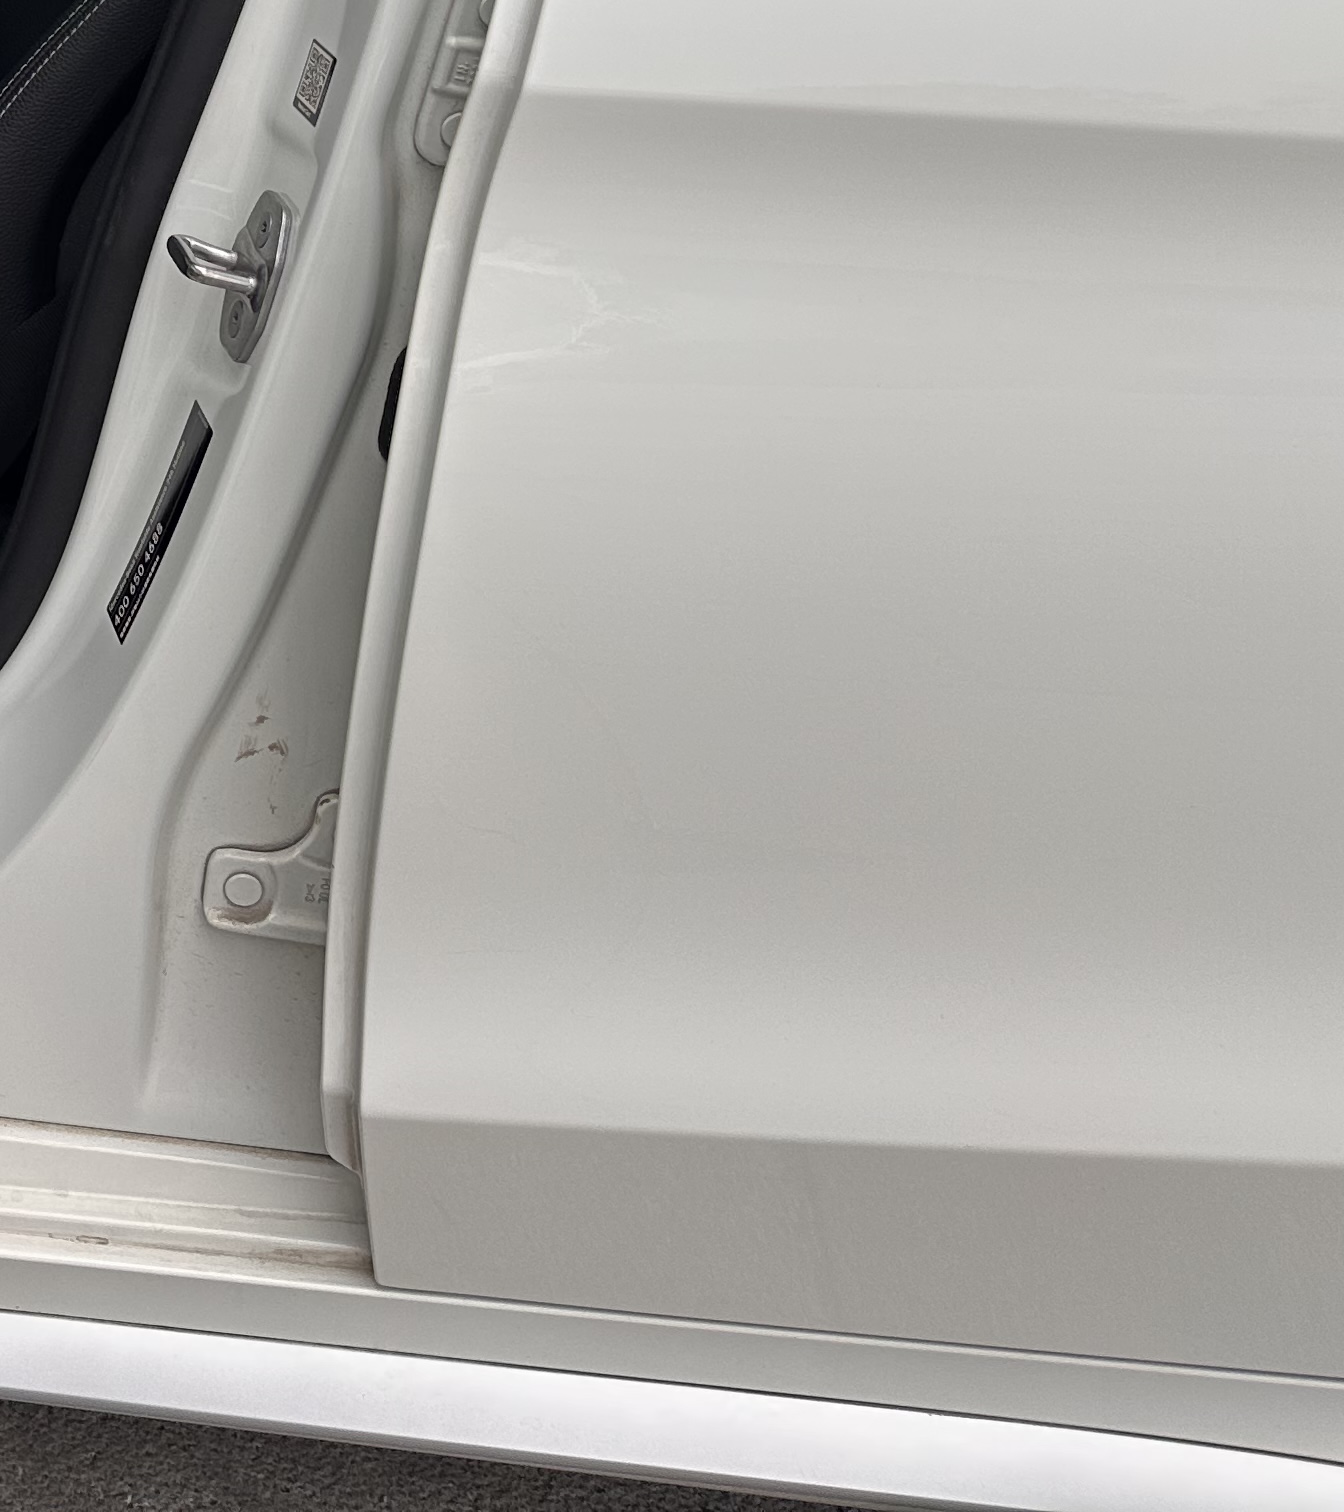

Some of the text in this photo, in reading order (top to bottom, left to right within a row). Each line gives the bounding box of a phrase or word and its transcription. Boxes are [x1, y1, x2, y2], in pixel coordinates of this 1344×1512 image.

[114, 522, 163, 626] 400 650 4688
